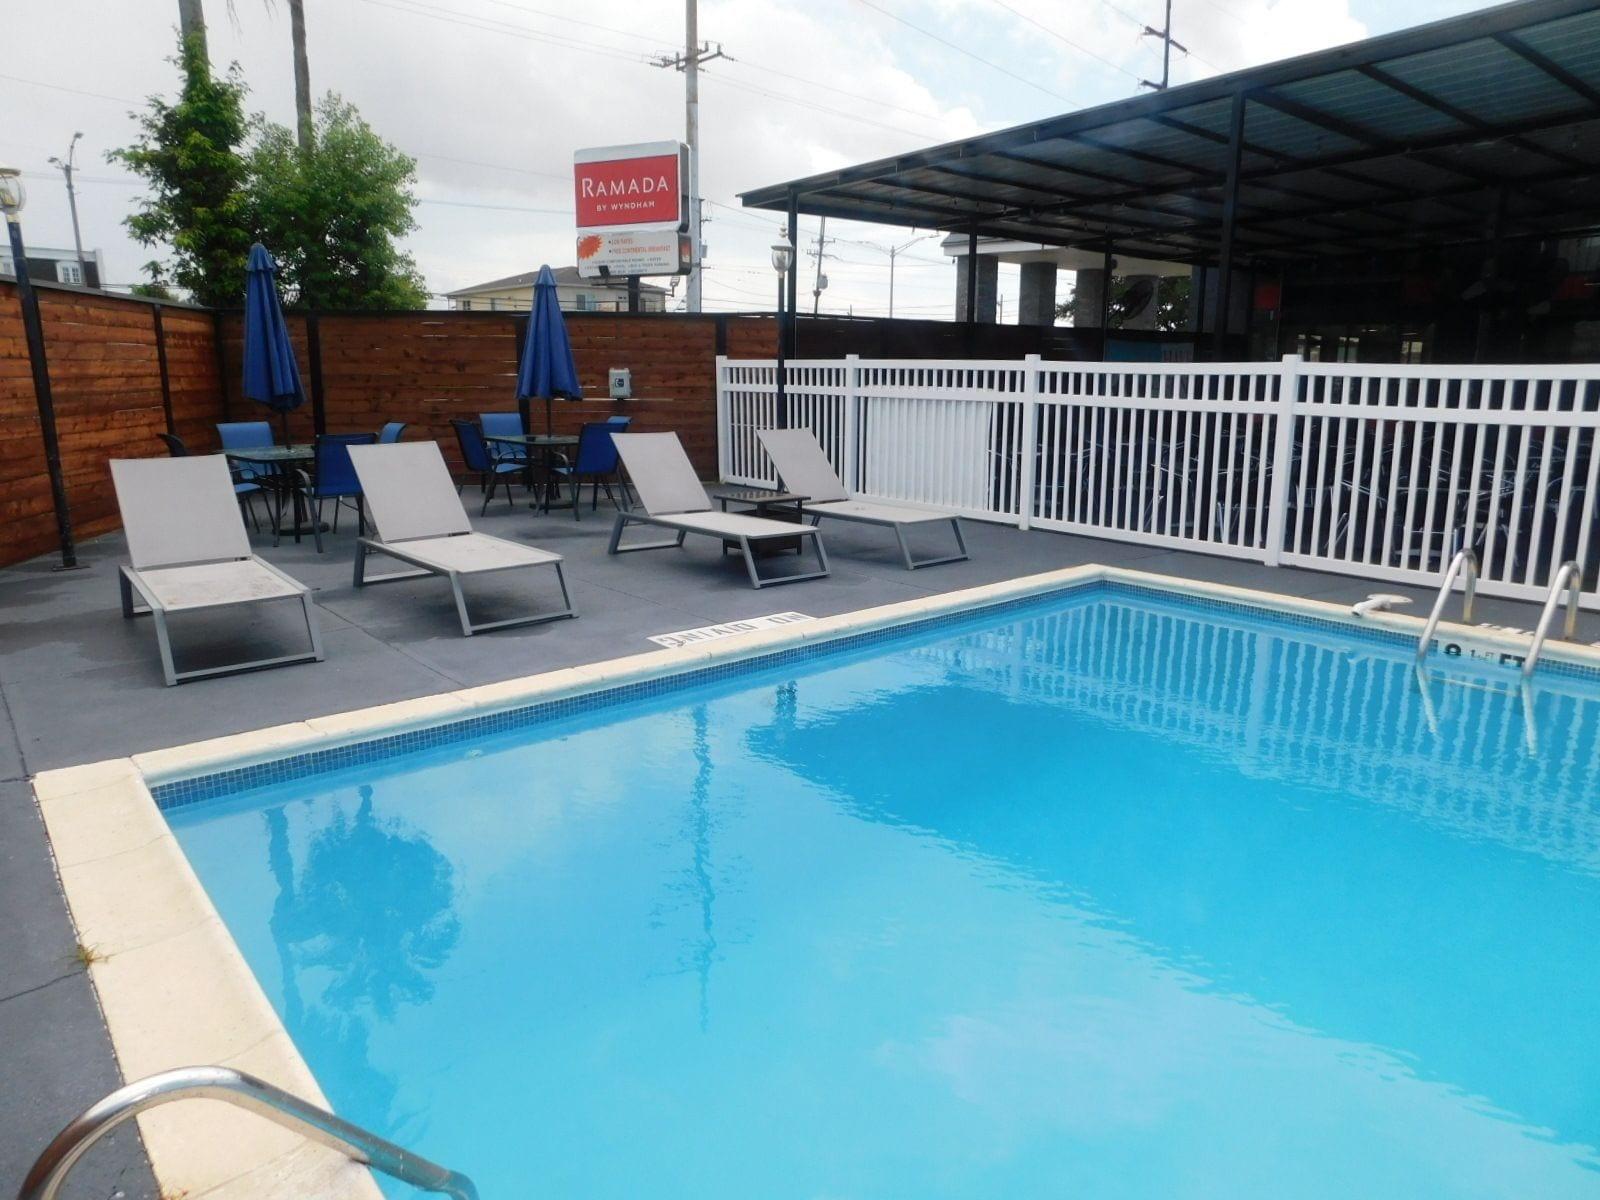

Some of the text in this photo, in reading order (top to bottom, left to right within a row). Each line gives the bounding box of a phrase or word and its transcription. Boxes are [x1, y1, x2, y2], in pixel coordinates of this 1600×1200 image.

[581, 175, 669, 198] RAMADA
[596, 200, 656, 212] BY WYNDHAM
